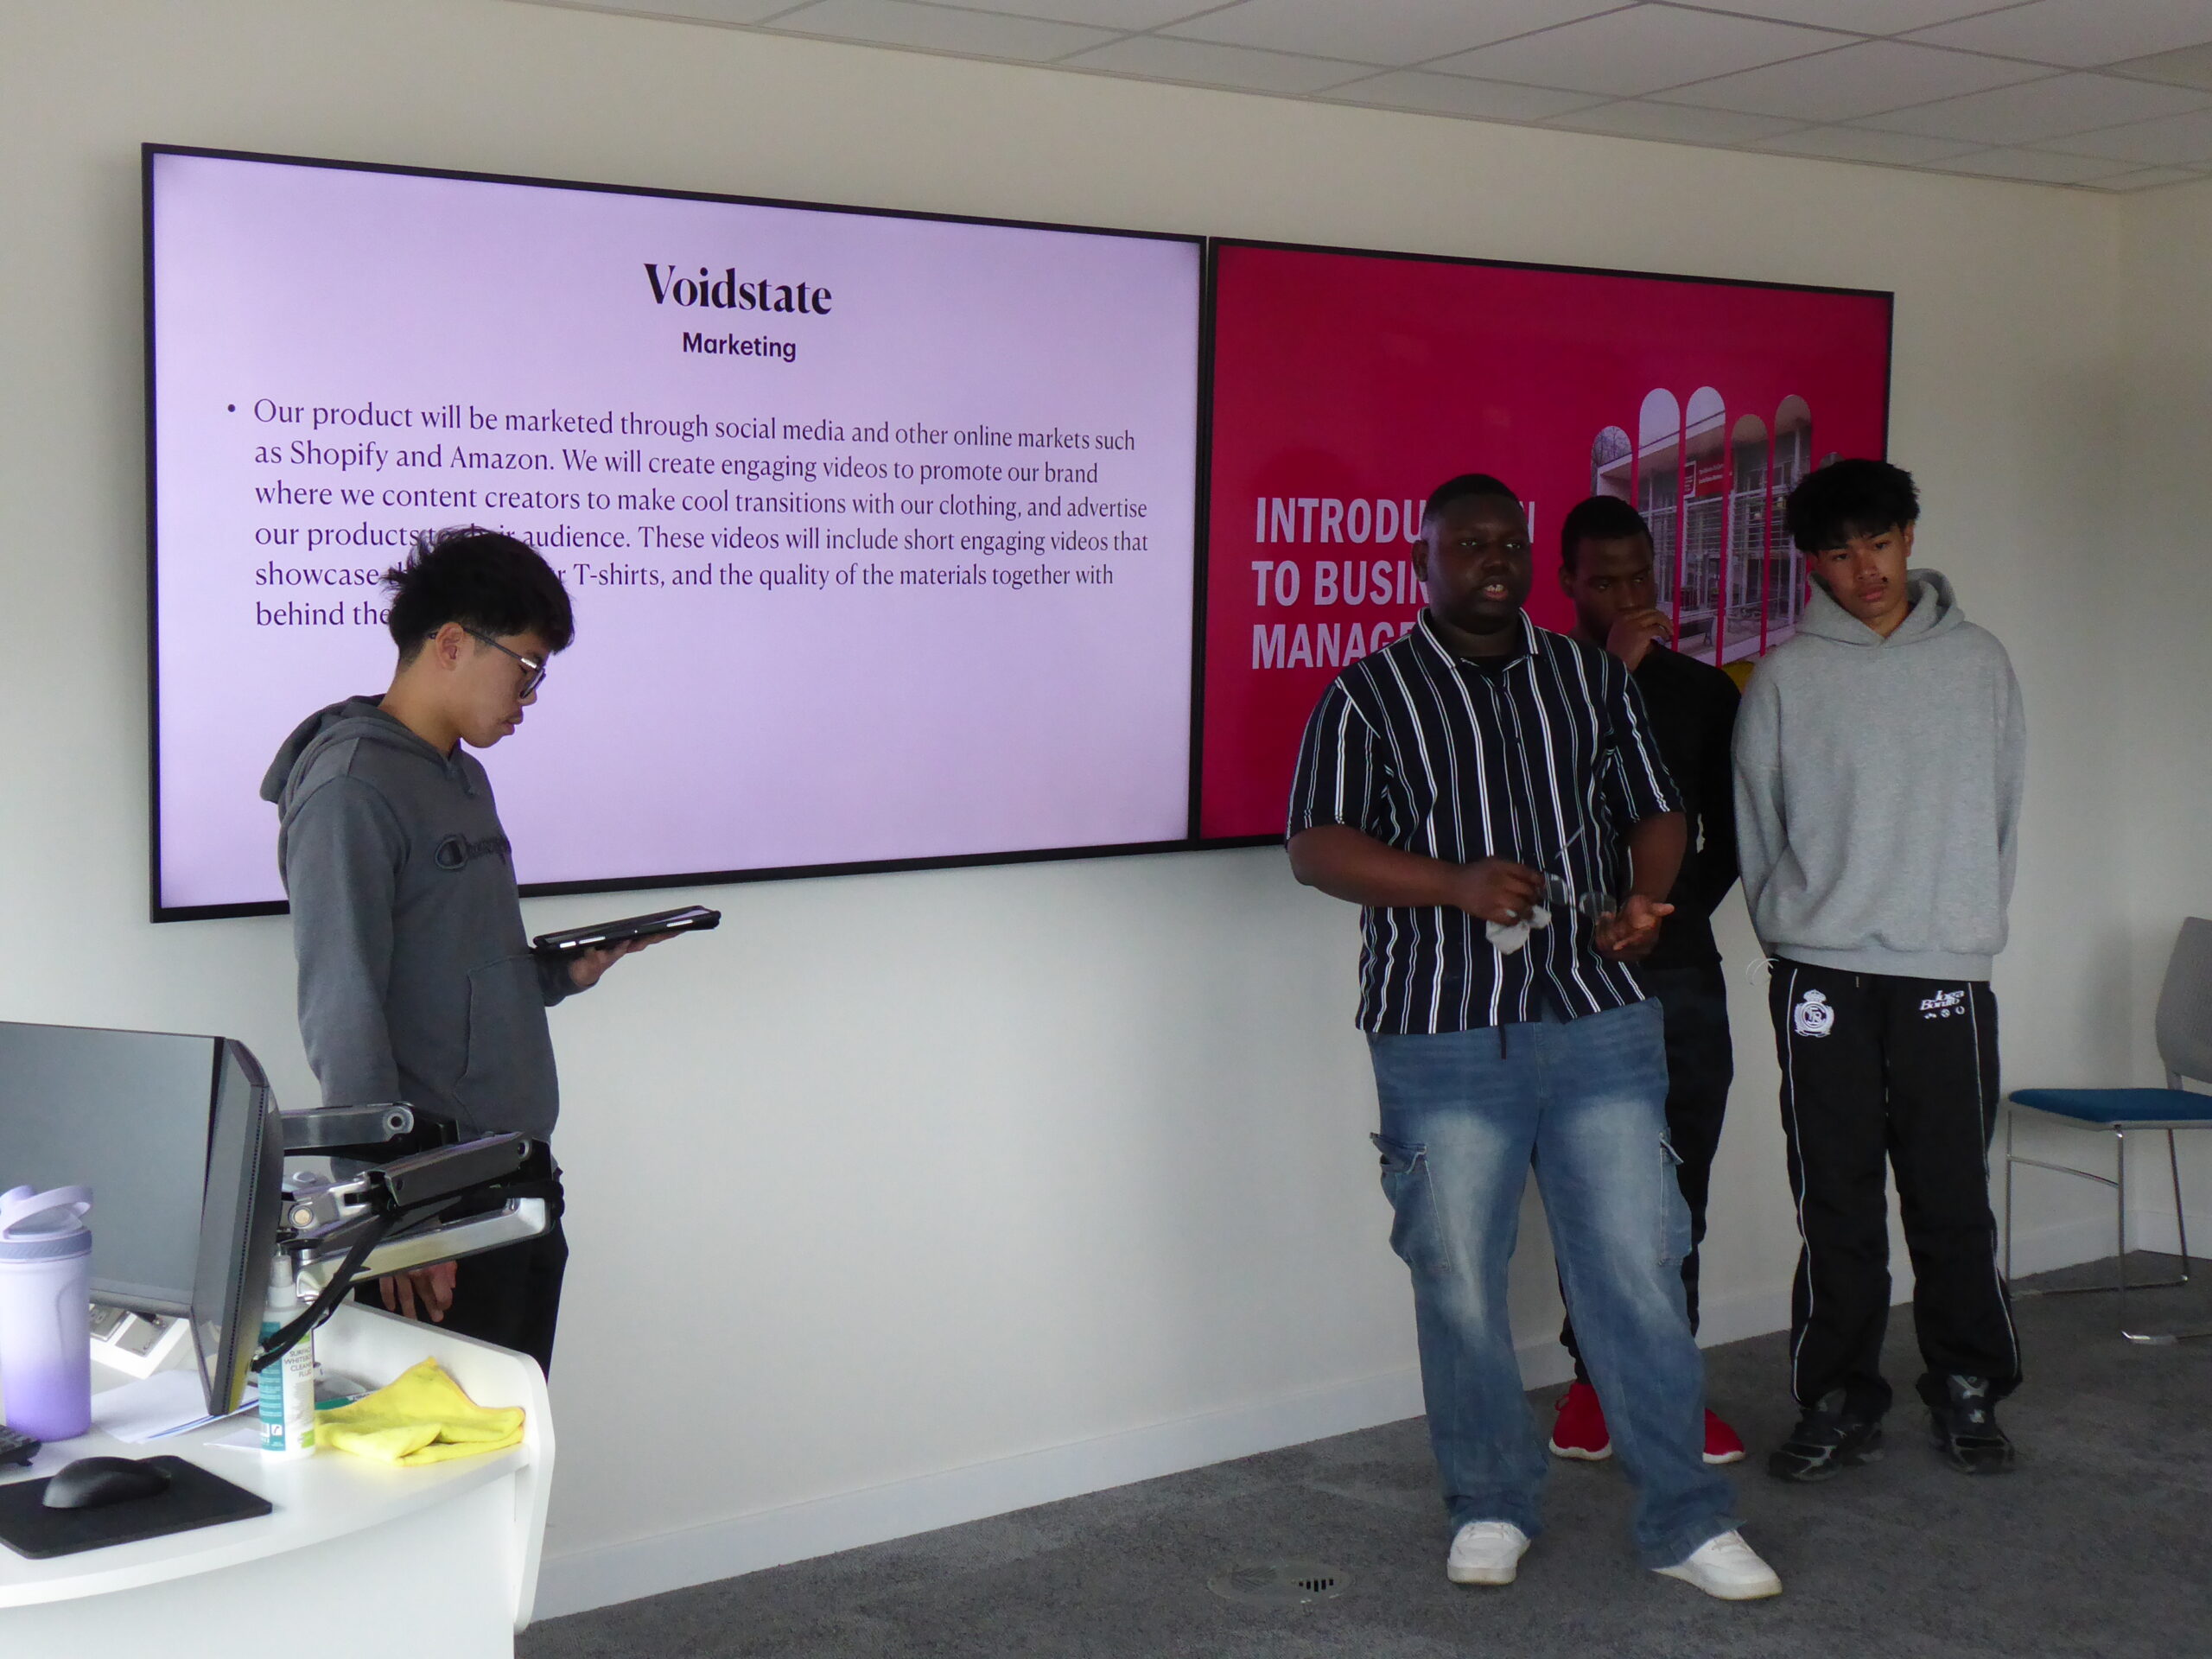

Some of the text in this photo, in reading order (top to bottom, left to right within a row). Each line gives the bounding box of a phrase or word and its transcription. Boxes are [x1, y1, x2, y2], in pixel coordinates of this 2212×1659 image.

[642, 263, 833, 315] Voidstate
[683, 331, 797, 364] Marketing
[253, 397, 1135, 451] Our product will be marketed through social media and other online markets such
[254, 439, 1098, 486] as Shopify and Amazon. We will create engaging videos to promote our brand
[254, 479, 1147, 522] where we content creators to make cool transitions with our clothing, and advertise
[1255, 497, 1535, 543] INTRODU
[255, 527, 300, 545] our
[307, 520, 420, 552] products
[523, 523, 632, 549] audience.
[637, 524, 705, 549] These
[710, 525, 779, 550] videos
[785, 526, 820, 550] will
[826, 527, 899, 550] include
[904, 527, 955, 550] short
[960, 530, 1046, 556] engaging
[1050, 529, 1109, 551] videos
[1113, 530, 1148, 551] that
[255, 560, 380, 587] showcase
[573, 562, 665, 588] T-shirts,
[671, 562, 713, 586] and
[719, 562, 753, 586] the
[759, 562, 830, 591] quality
[835, 562, 859, 586] of
[862, 563, 894, 586] the
[899, 563, 987, 586] materials
[992, 563, 1071, 590] together
[1075, 563, 1114, 585] with
[1251, 560, 1430, 607] TO BUSIN
[255, 601, 345, 626] behind
[1251, 621, 1416, 670] MANAG
